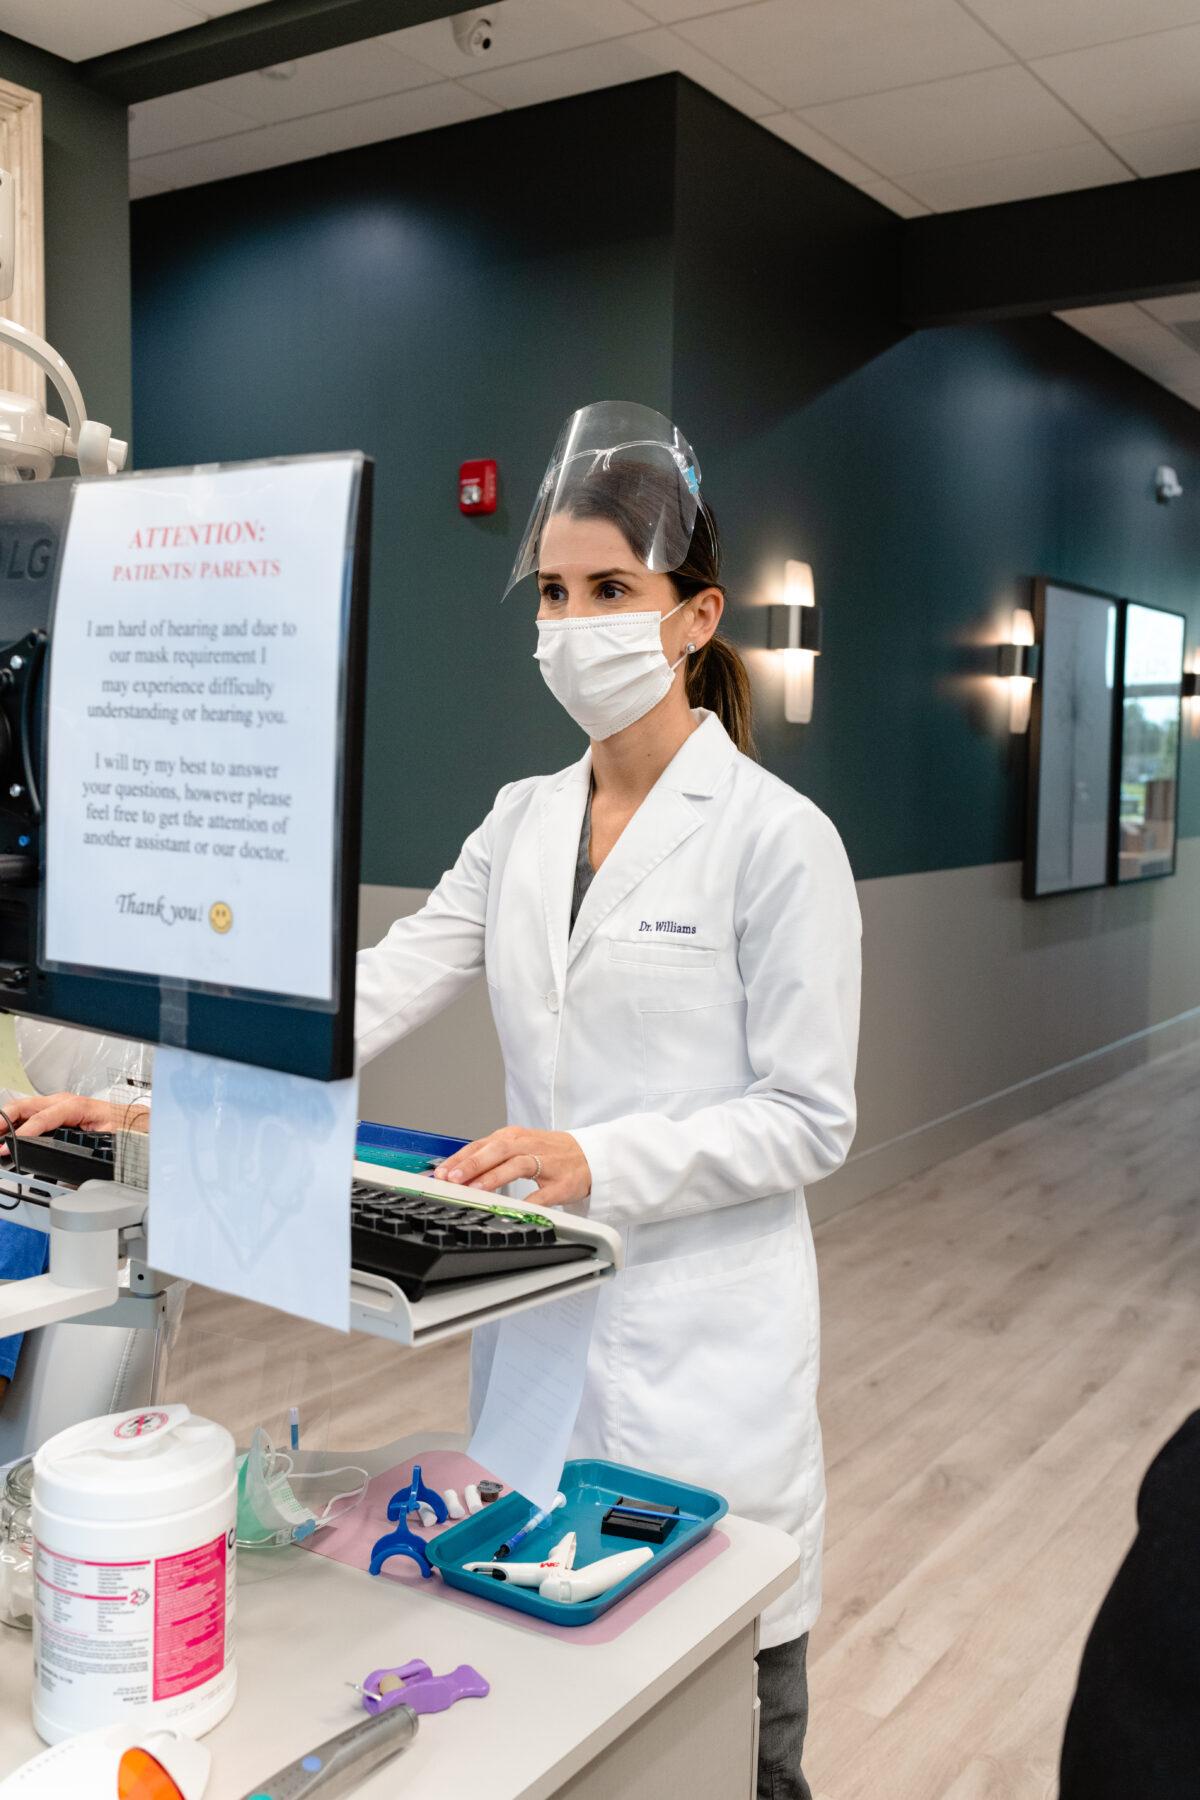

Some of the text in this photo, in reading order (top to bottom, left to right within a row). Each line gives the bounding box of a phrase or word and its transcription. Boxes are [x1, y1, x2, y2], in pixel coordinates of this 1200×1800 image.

[129, 519, 266, 550] ATTENTION:
[7, 538, 53, 580] LG
[200, 559, 282, 578] PARENTS
[86, 619, 298, 641] I am hard of hearing and due to
[109, 646, 267, 668] our mask requirement I
[102, 676, 274, 700] may experience difficulty
[87, 702, 288, 728] understanding or hearing you.
[95, 752, 279, 778] I will try my best to answer
[82, 781, 292, 808] your questions, however please
[86, 803, 290, 834] feel free to get the attention of
[83, 830, 289, 862] another assistant or our doctor.
[116, 892, 204, 926] Thank you!
[639, 921, 696, 935] Dr. Williams
